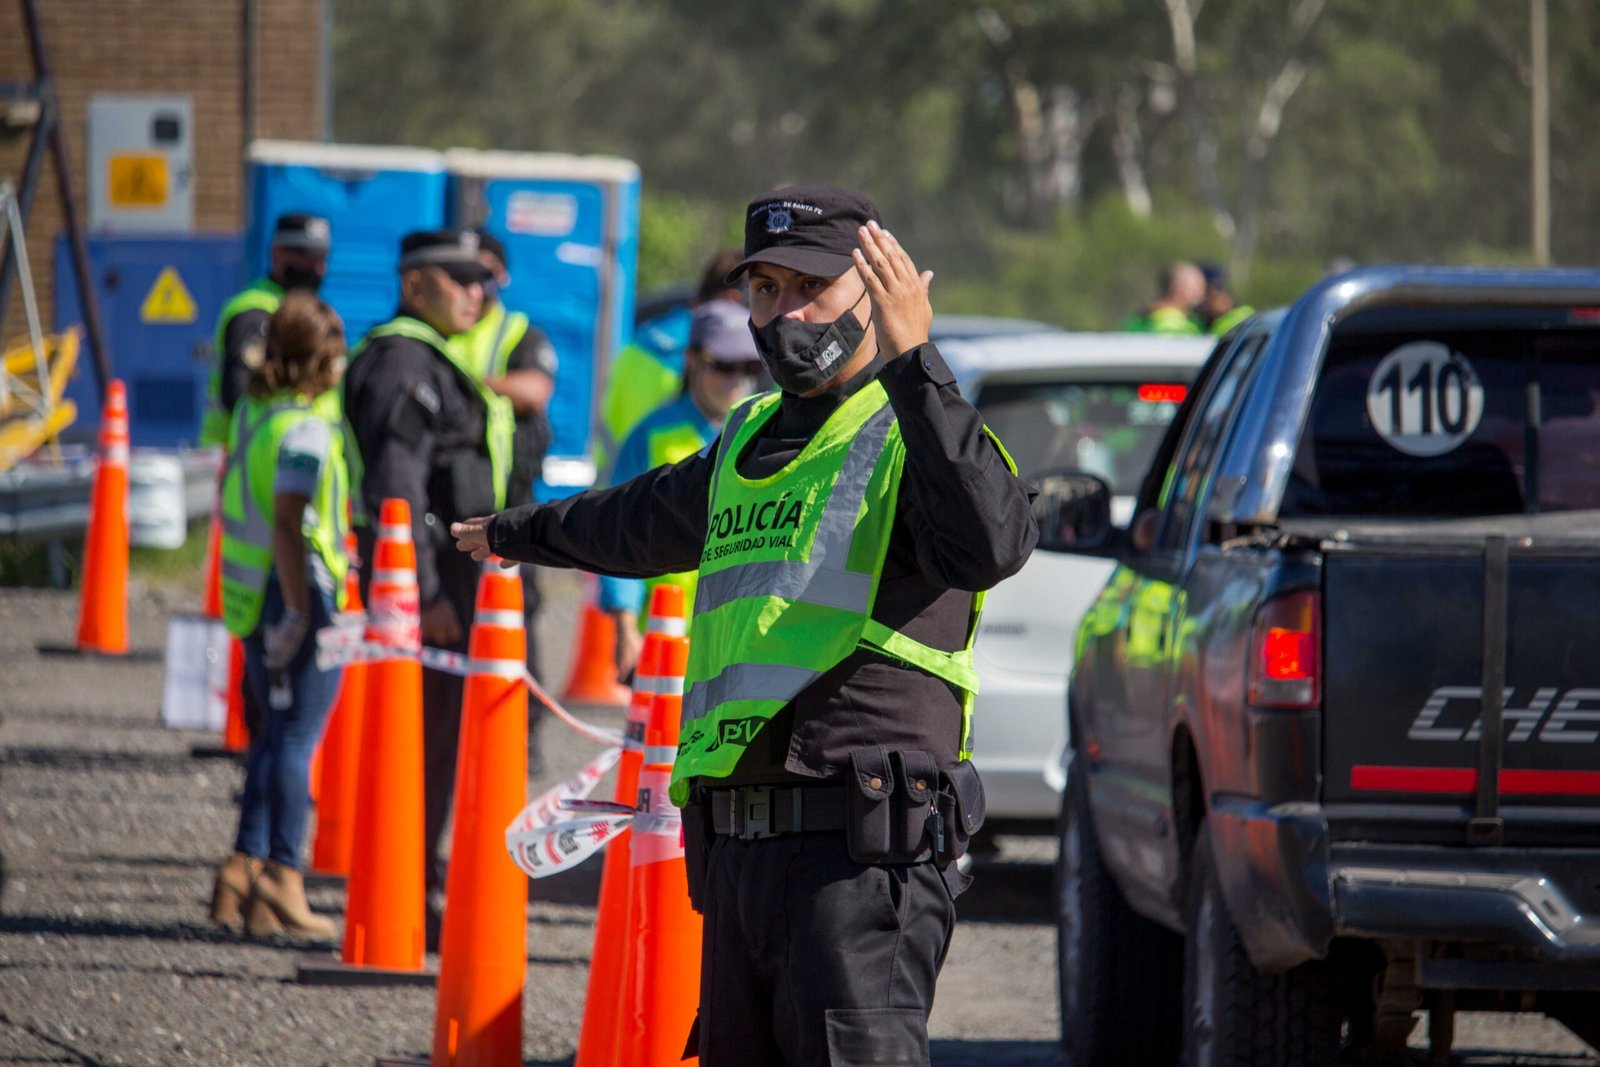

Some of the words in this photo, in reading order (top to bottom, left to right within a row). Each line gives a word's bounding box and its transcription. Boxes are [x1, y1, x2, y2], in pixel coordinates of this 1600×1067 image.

[792, 202, 813, 212] SANTA
[813, 207, 824, 216] FE
[1378, 360, 1469, 437] 110
[706, 492, 803, 545] POLICÍA
[701, 548, 712, 564] DE
[713, 536, 767, 561] SEGURIDAD
[769, 535, 794, 549] VIAL
[1407, 685, 1600, 743] CHE
